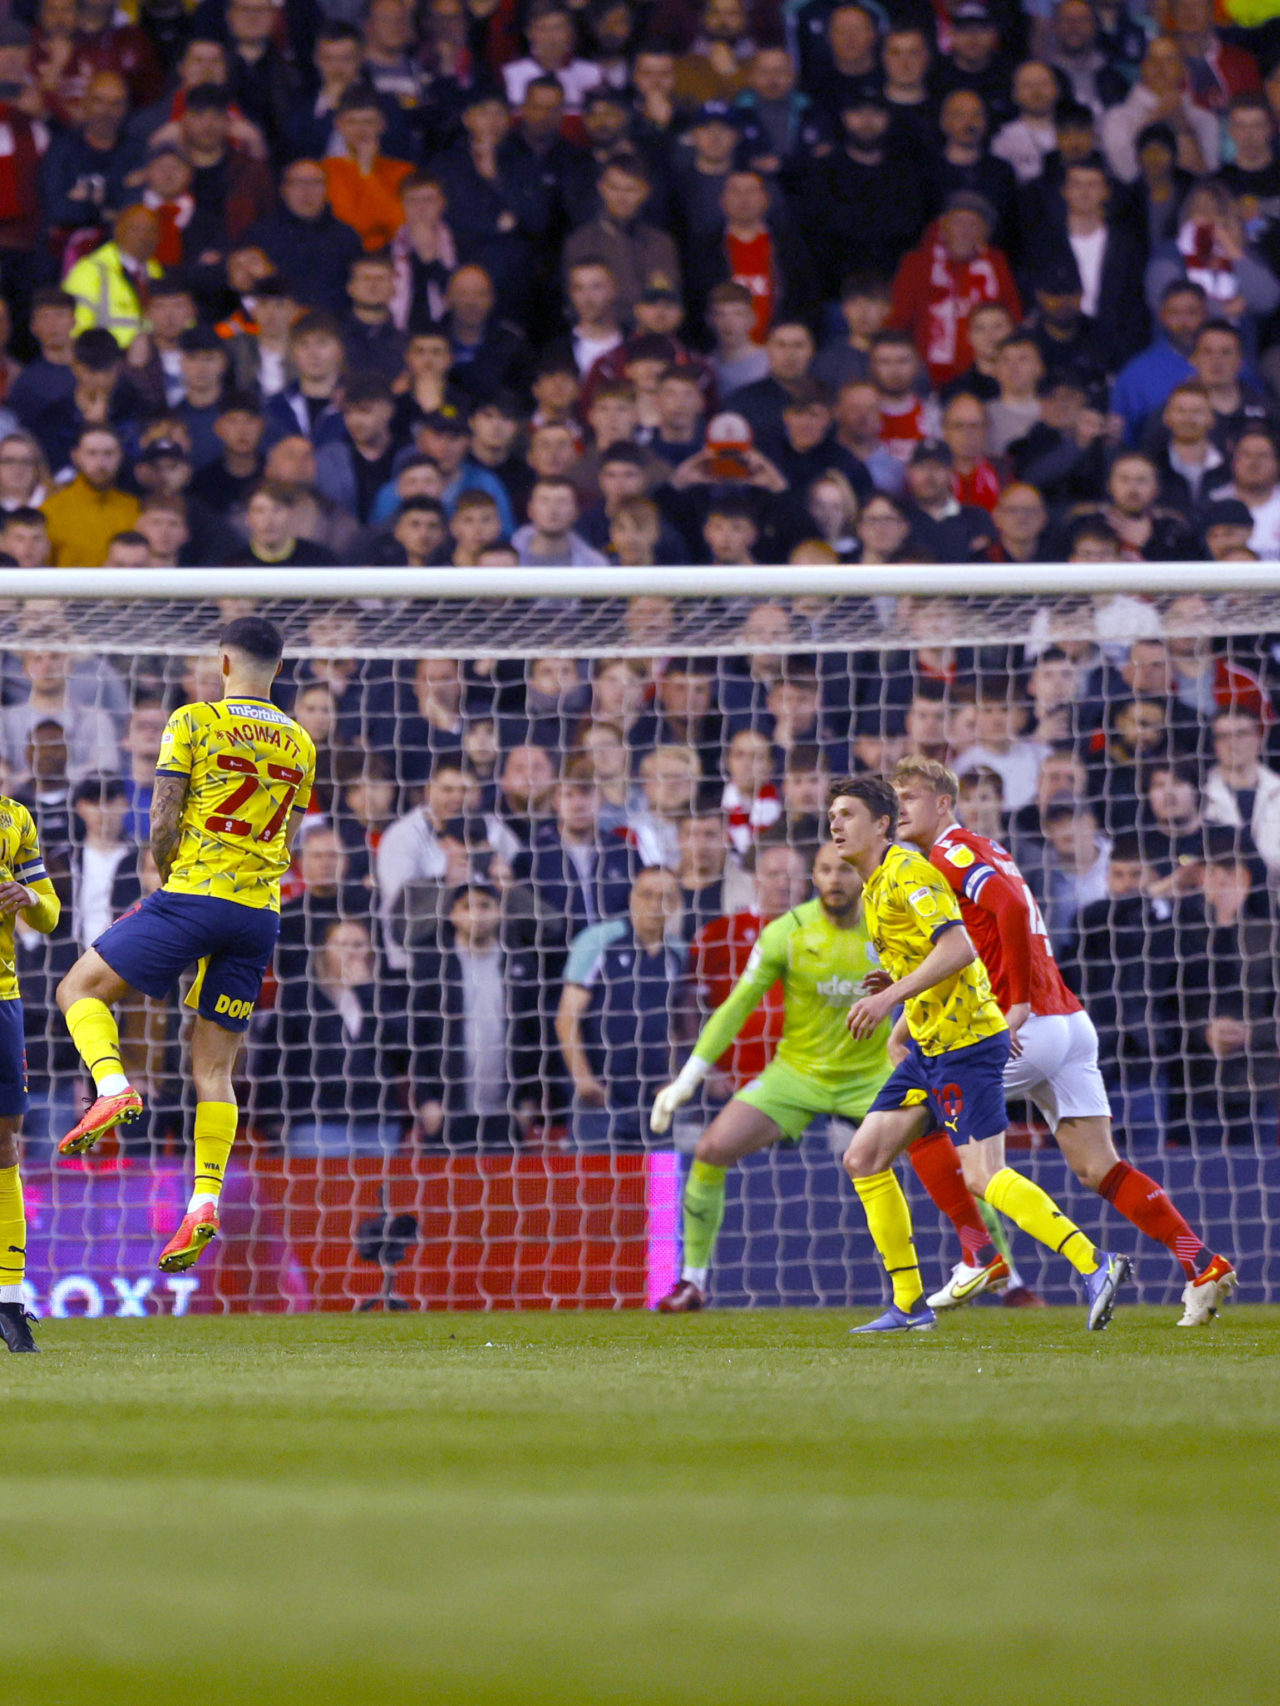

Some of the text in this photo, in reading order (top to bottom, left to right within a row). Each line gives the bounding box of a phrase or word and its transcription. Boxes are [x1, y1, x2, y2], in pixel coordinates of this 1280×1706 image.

[225, 724, 301, 759] MOWATT
[204, 754, 305, 843] 27
[816, 976, 869, 996] idea
